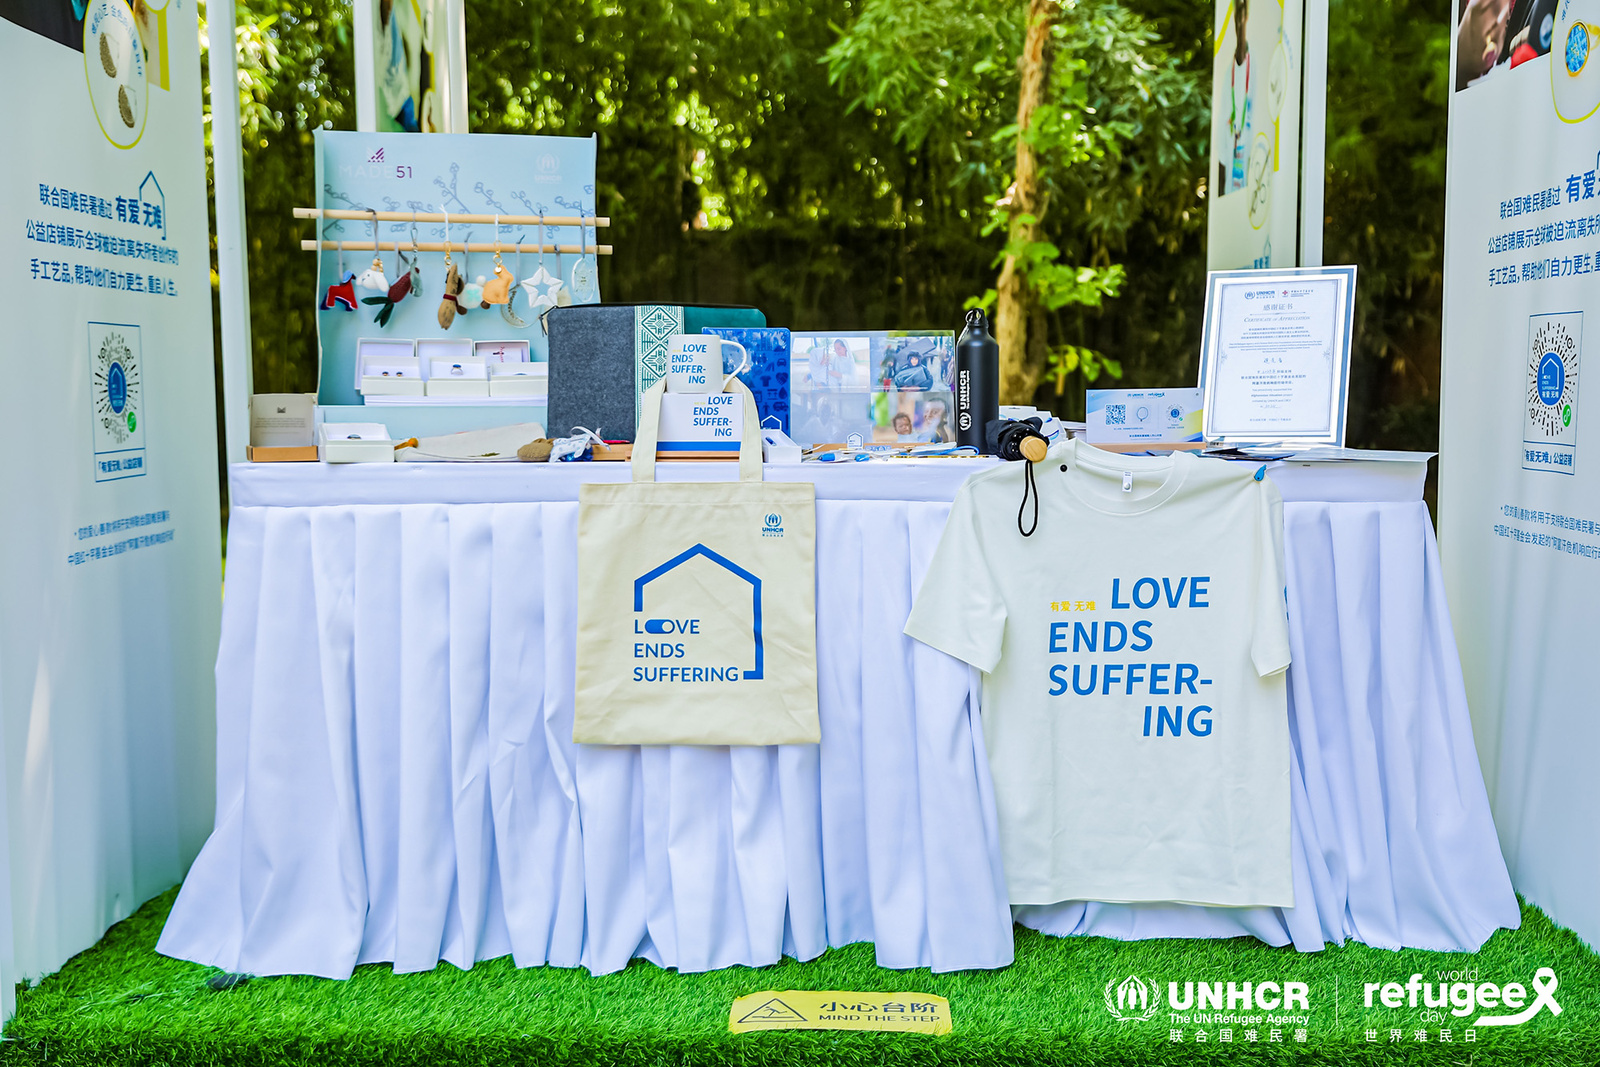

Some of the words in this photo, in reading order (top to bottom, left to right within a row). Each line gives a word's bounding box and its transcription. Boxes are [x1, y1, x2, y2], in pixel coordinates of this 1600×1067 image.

[1565, 169, 1596, 204] 有爱
[115, 195, 140, 225] 有爱
[142, 202, 163, 229] 无难
[683, 344, 707, 353] LOVE
[671, 354, 694, 363] ENDS
[671, 365, 706, 374] SUFFER-
[688, 375, 706, 384] ING
[959, 370, 967, 409] UNHCR
[707, 396, 733, 405] LOVE
[693, 407, 719, 415] ENDS
[693, 417, 732, 426] SUFFER-
[714, 428, 732, 437] ING
[1111, 576, 1211, 609] LOVE
[1050, 601, 1071, 612] 有爱
[1074, 600, 1096, 612] 无难
[1049, 620, 1153, 653] ENDS
[634, 643, 685, 658] ENDS
[633, 667, 739, 682] SUFFERING
[1048, 663, 1213, 696] SUFFER-
[1143, 705, 1213, 737] ING
[819, 1001, 938, 1013] 小心台阶
[865, 1014, 896, 1022] THE
[900, 1015, 940, 1023] STEP
